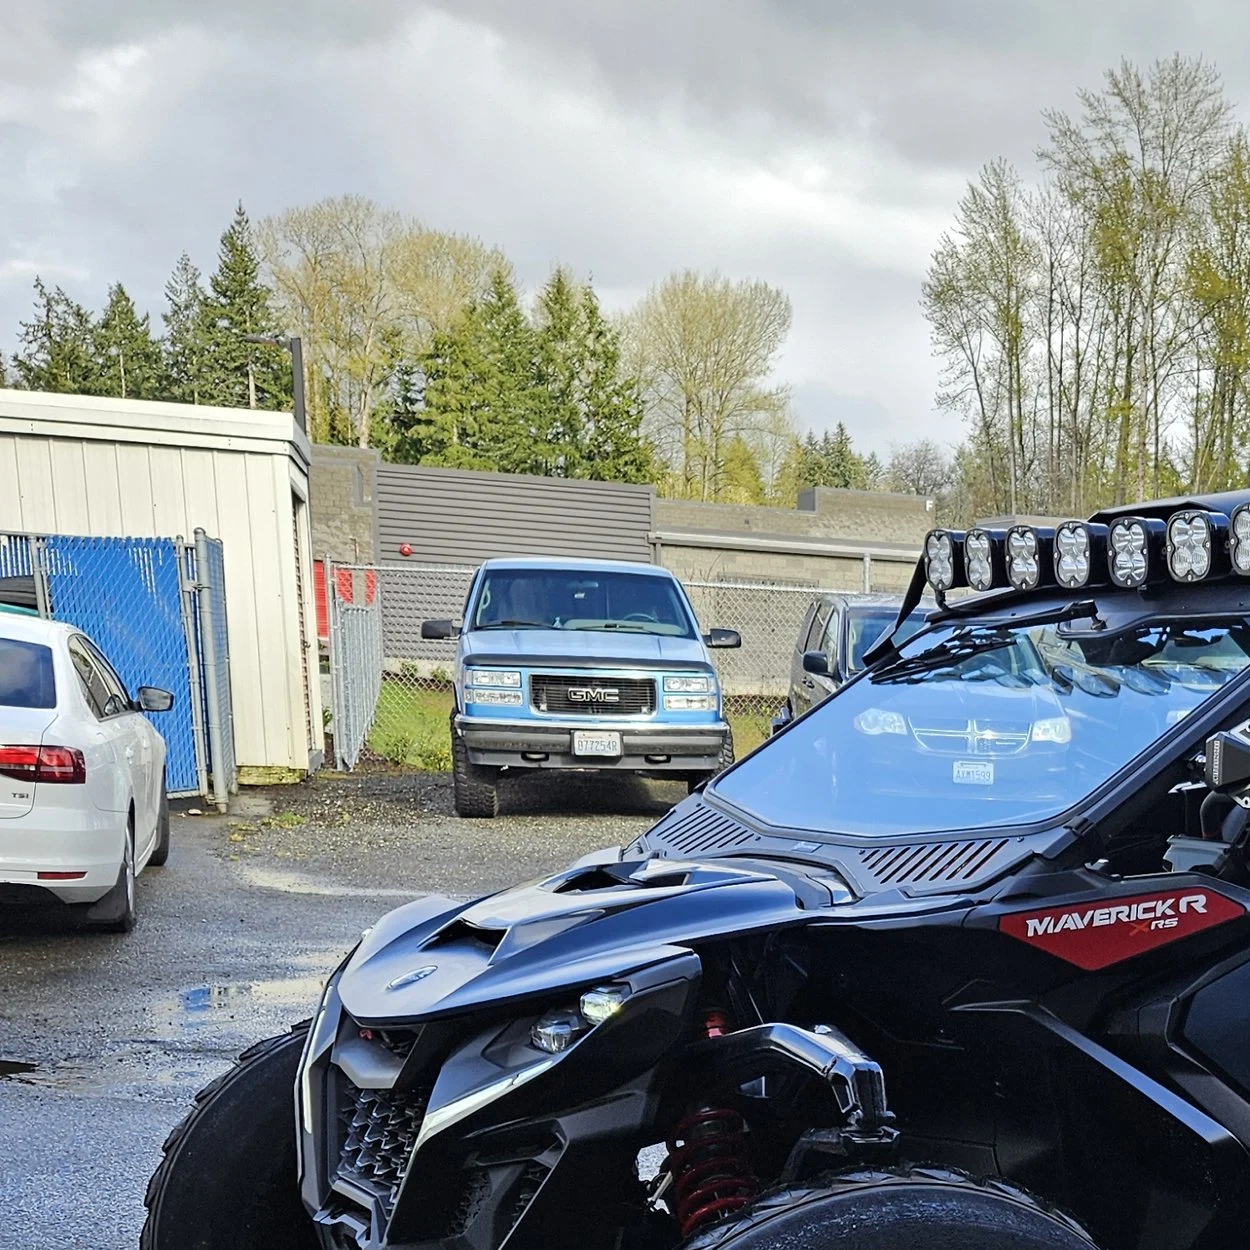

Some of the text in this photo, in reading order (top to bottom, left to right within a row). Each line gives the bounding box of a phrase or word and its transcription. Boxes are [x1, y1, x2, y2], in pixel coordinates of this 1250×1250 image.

[926, 500, 933, 511] F
[568, 687, 619, 702] GMC
[1025, 894, 1208, 938] MAVERICK R
